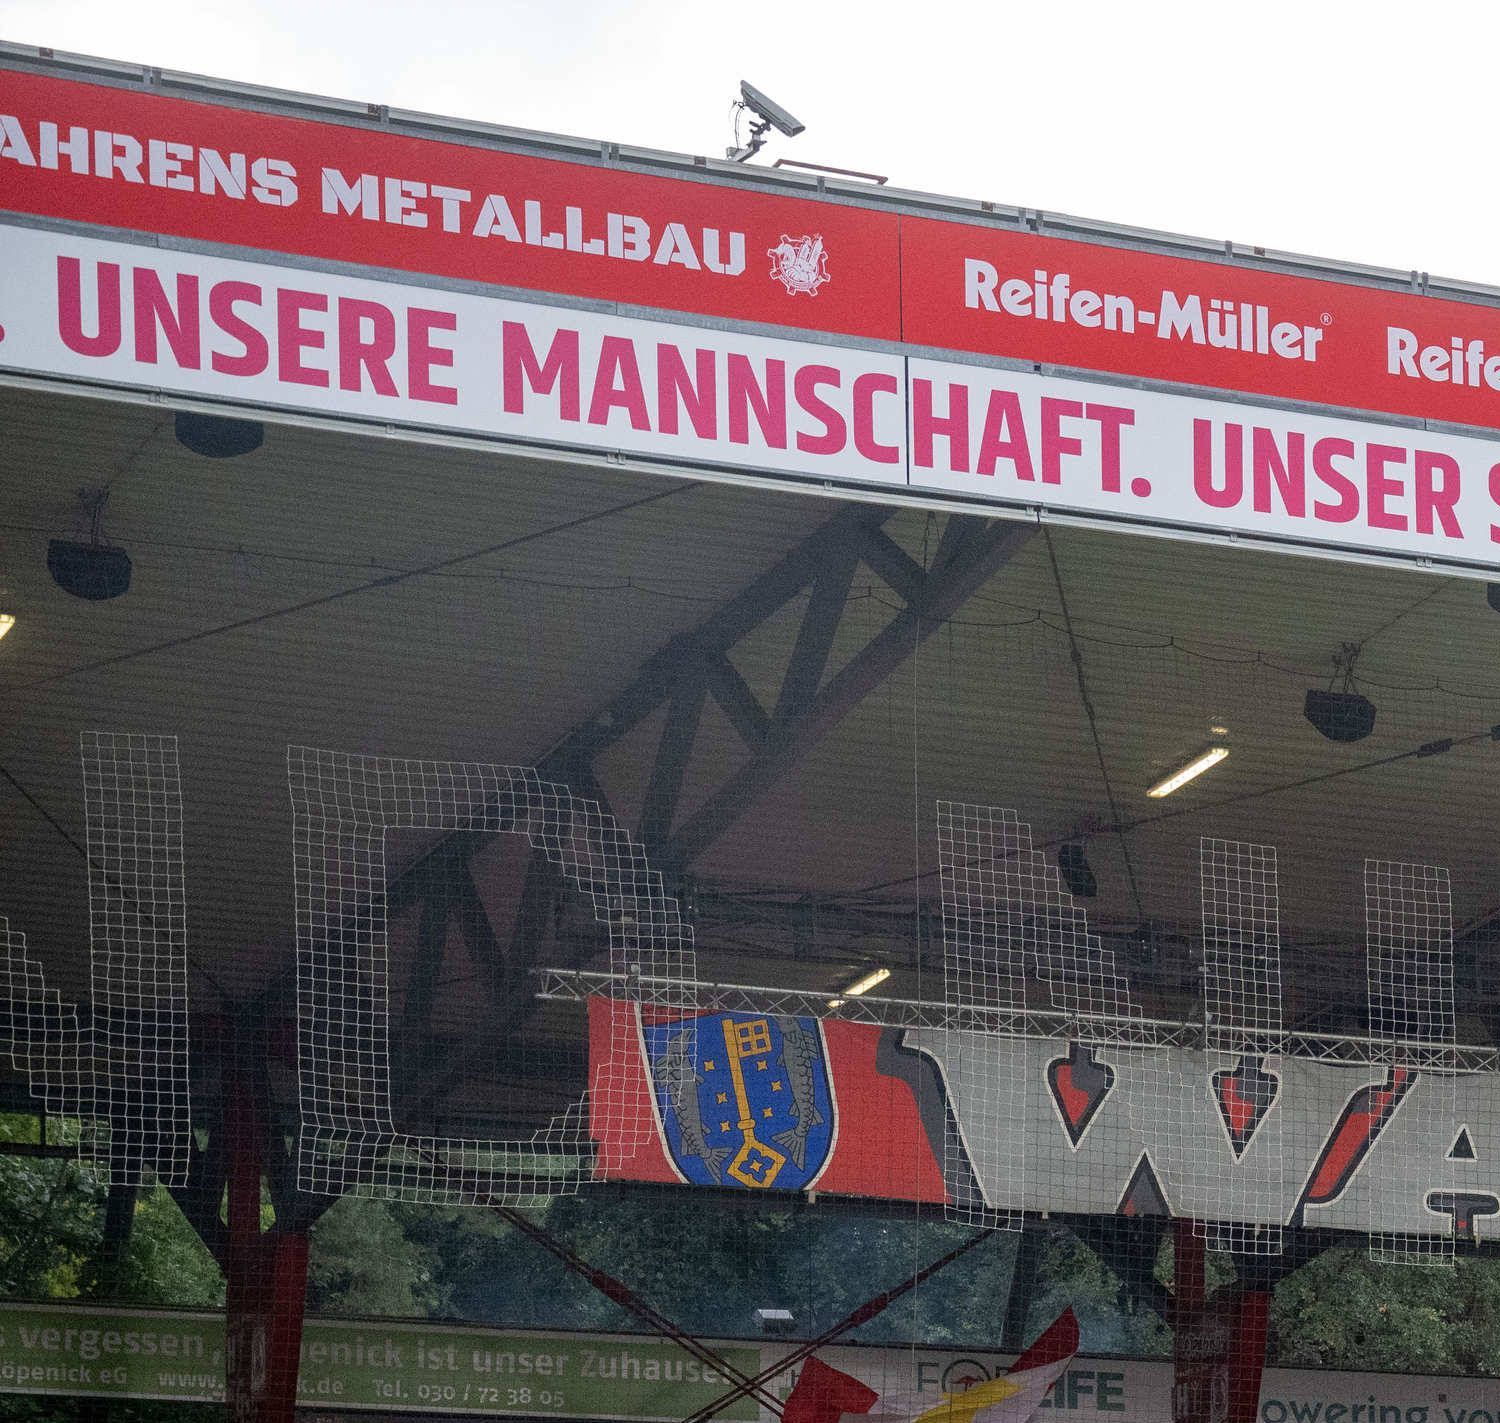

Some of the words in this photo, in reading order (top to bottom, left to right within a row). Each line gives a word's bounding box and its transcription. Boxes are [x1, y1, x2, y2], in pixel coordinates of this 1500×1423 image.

[0, 114, 299, 208] AHRENS
[321, 166, 747, 277] METALLBAU
[963, 257, 1325, 363] Reifen-Müller
[56, 255, 459, 406] UNSERE
[501, 319, 1153, 499] MANNSCHAFT.
[1193, 418, 1465, 540] UNSER
[101, 1366, 129, 1385] eG
[374, 1377, 409, 1398] Tel.
[416, 1384, 454, 1401] 030
[507, 1386, 532, 1406] 38
[539, 1389, 564, 1408] 05
[418, 1338, 460, 1372] ist
[472, 1346, 569, 1377] unser
